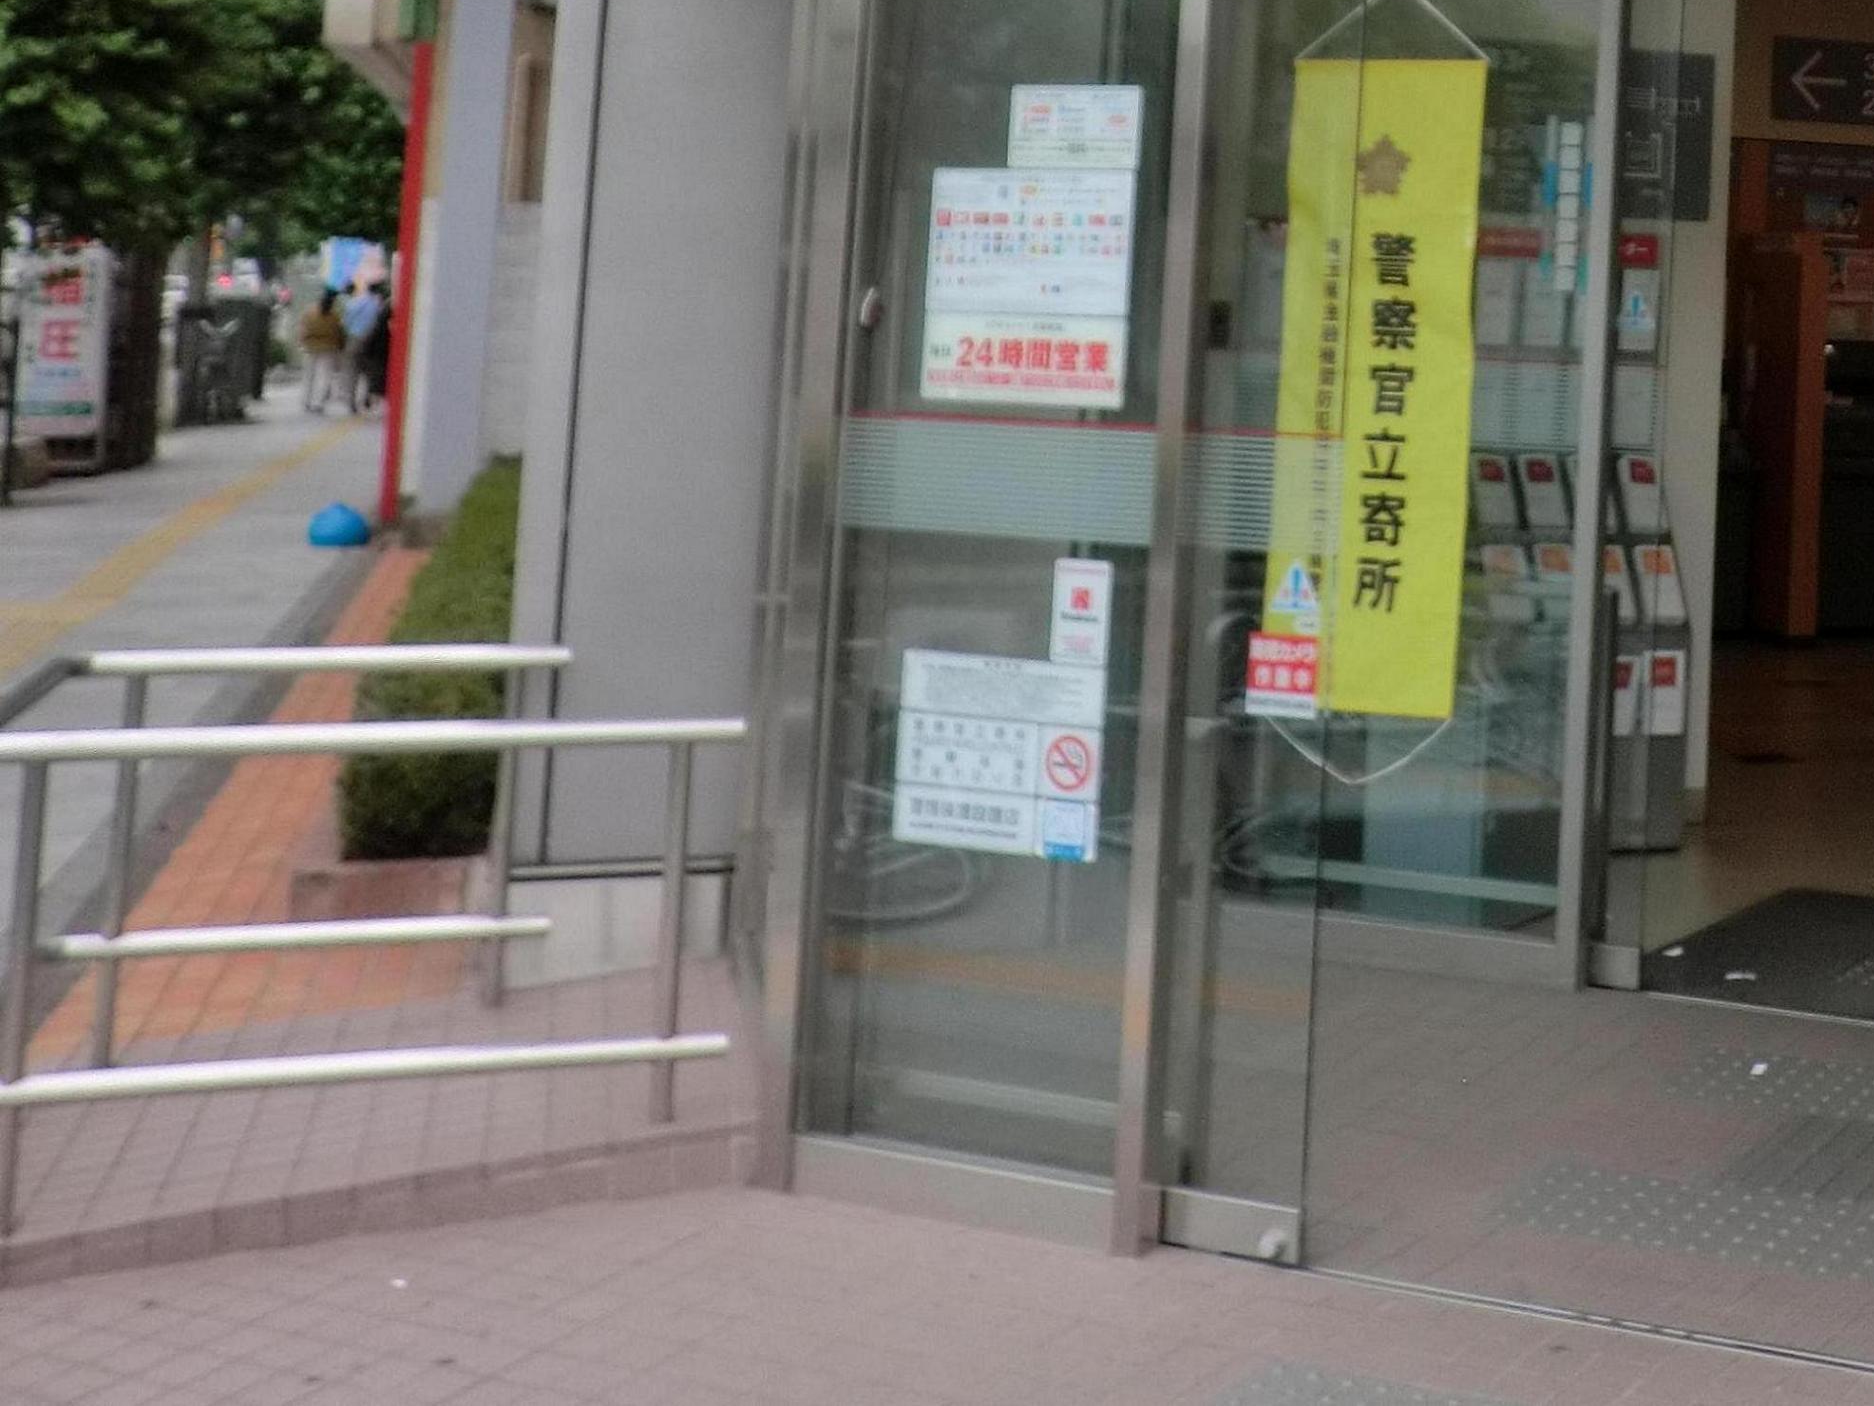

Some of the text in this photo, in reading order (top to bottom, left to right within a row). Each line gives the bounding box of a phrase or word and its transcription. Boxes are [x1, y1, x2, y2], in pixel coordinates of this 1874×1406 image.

[1352, 231, 1418, 616] 警察官立寄所
